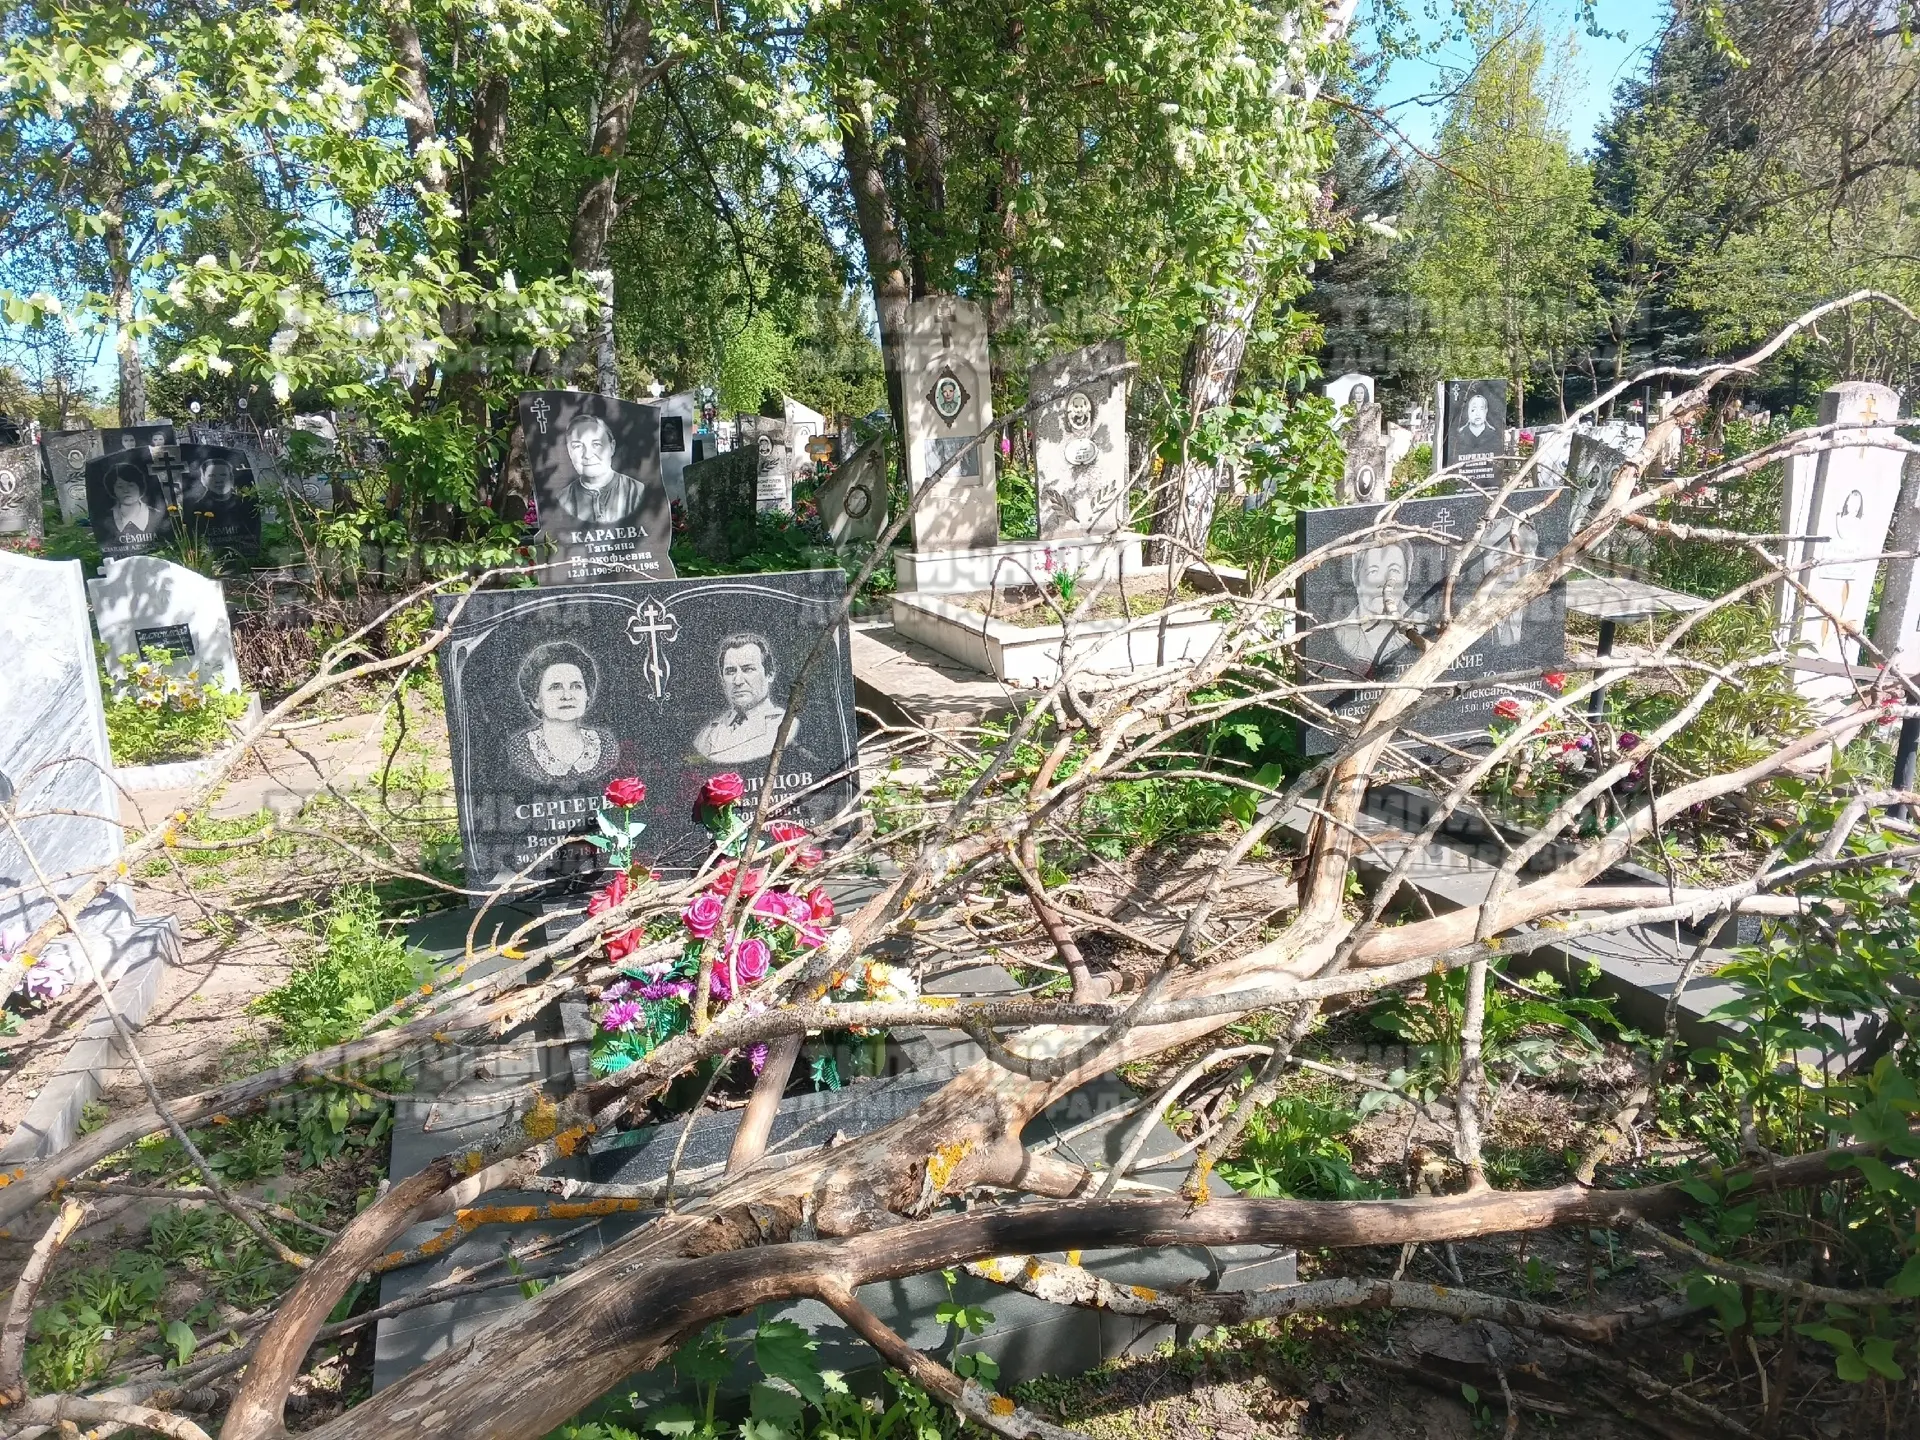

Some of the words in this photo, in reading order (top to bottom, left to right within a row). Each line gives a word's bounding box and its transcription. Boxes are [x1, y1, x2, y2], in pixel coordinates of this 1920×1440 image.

[571, 525, 648, 544] КАРАЕВА
[585, 541, 635, 554] Татьяна
[571, 551, 652, 568] Прокофьевна
[515, 795, 614, 820] СЕРГЕЕВ
[544, 816, 598, 832] Ларис
